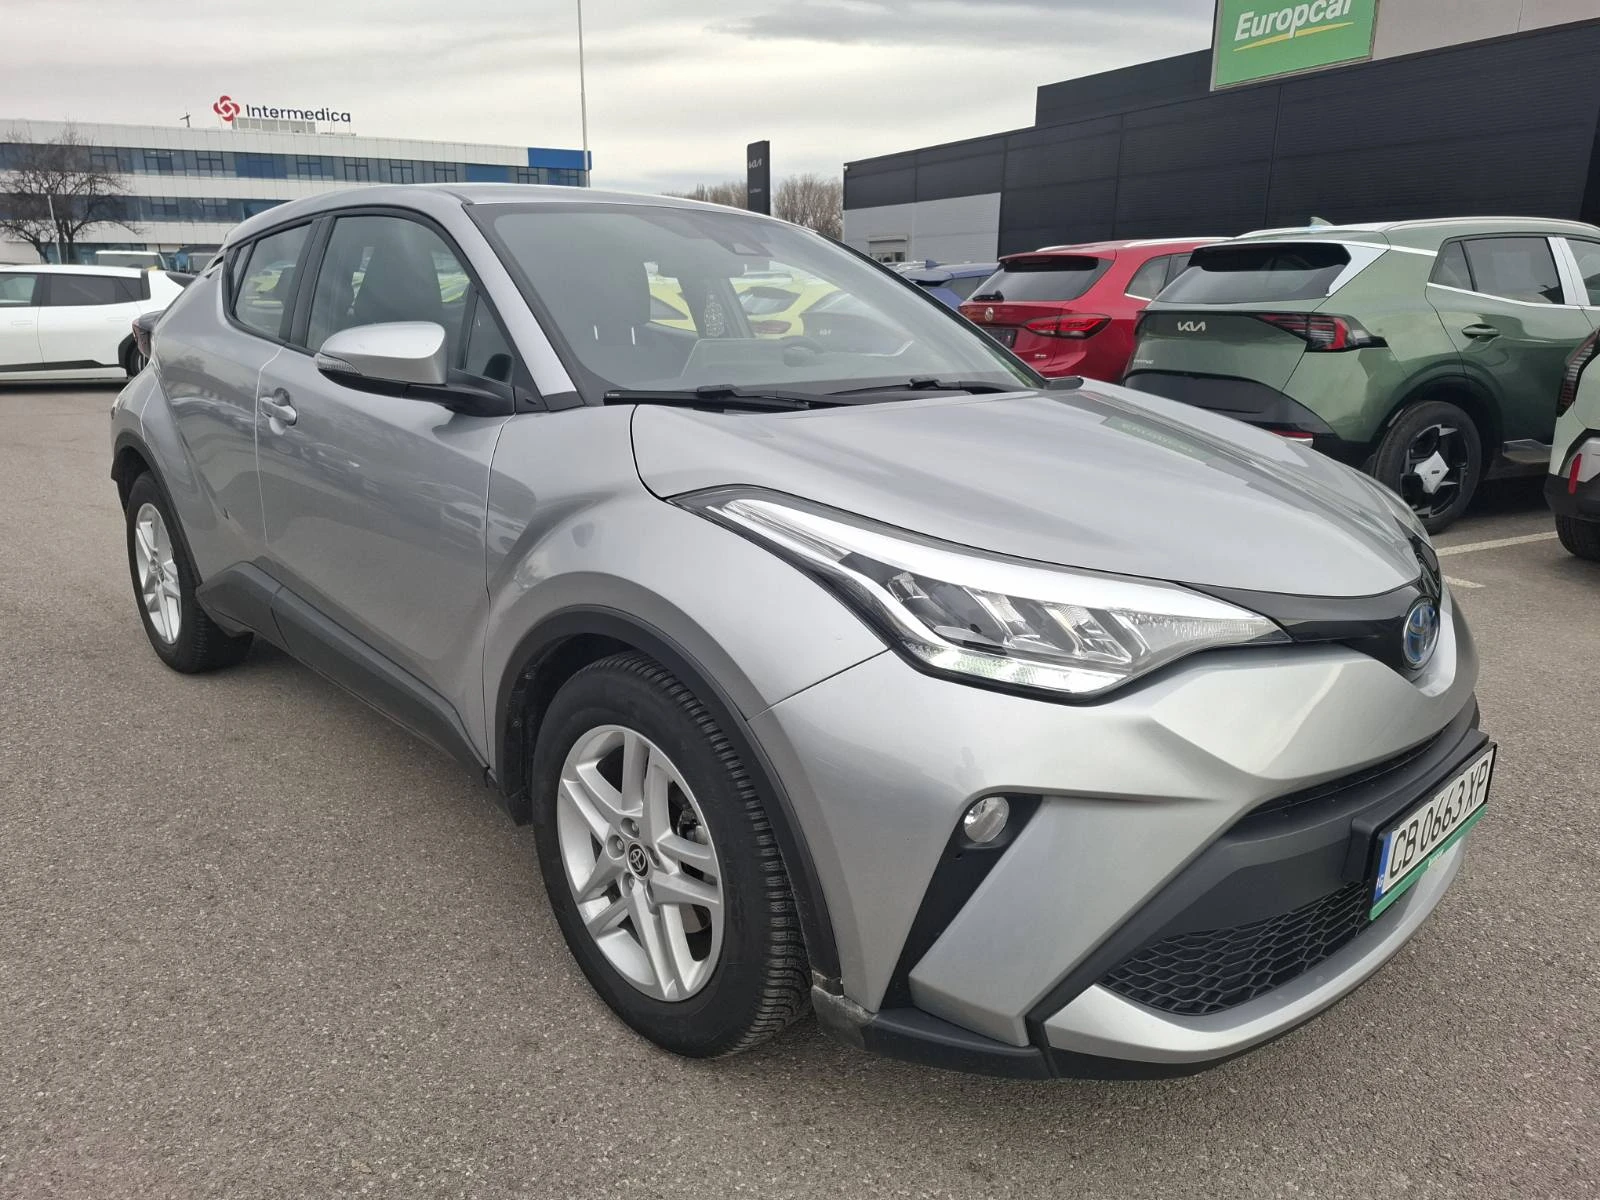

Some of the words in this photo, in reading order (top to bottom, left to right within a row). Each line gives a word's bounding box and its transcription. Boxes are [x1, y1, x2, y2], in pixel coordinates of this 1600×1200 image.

[1234, 0, 1351, 41] Europcar
[246, 104, 351, 123] Intermedica
[1177, 321, 1206, 332] KIA
